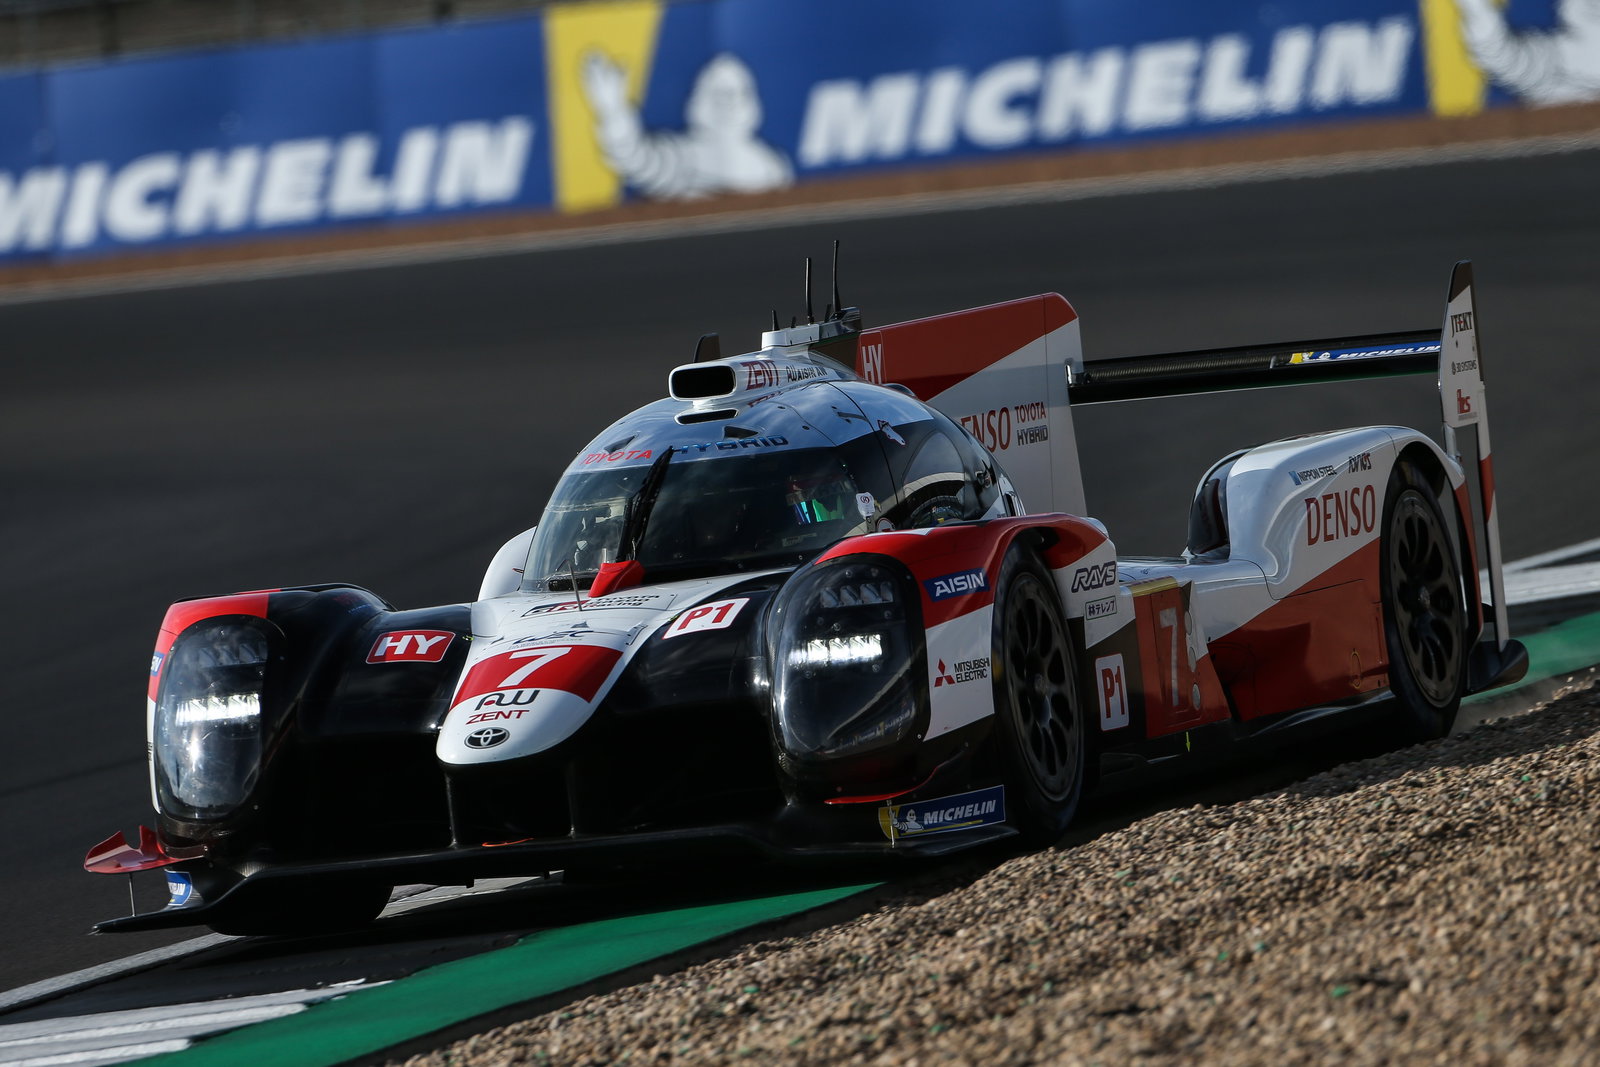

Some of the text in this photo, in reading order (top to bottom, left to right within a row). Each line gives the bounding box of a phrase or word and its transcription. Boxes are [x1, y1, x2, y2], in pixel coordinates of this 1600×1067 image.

[799, 17, 1414, 168] MICHELIN
[0, 116, 534, 254] MICHELIN
[1451, 312, 1472, 338] JTEKT
[740, 360, 779, 391] ZENT
[861, 343, 882, 385] HY
[1015, 401, 1046, 424] TOYOTA
[960, 407, 1011, 453] NSO
[1017, 425, 1048, 446] HYBRID
[578, 450, 653, 465] TOYOTA
[672, 435, 789, 455] HYBRID
[1305, 484, 1376, 546] DENSO
[934, 570, 986, 597] AISIN
[1071, 561, 1117, 593] RAYS
[676, 602, 736, 631] P1
[373, 634, 447, 657] HY
[1158, 606, 1180, 707] 7
[497, 646, 573, 689] 7
[954, 657, 990, 673] MITSUBISHI
[955, 668, 988, 684] ELECTRIC
[1101, 664, 1126, 719] P1
[465, 709, 530, 726] ZENT
[923, 799, 997, 826] MICHELIN
